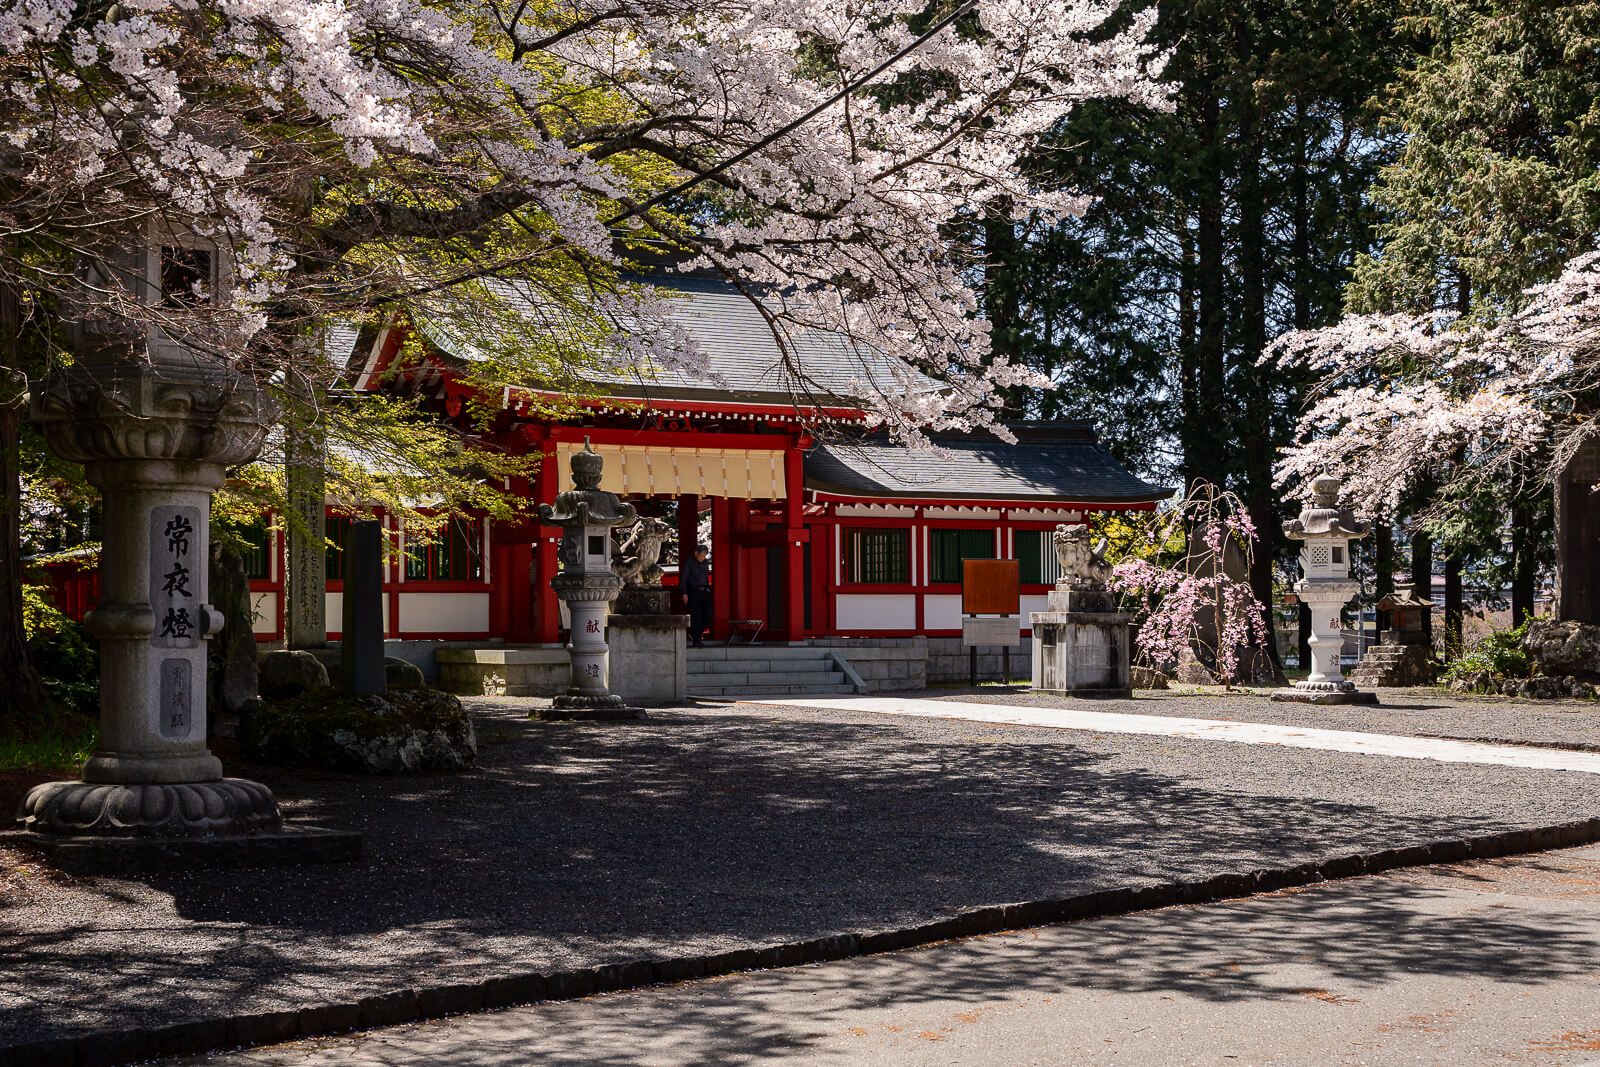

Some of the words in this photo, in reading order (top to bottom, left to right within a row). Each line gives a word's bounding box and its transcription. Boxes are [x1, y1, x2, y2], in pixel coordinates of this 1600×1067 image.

[159, 514, 194, 639] 常夜燈
[585, 619, 600, 679] 献燈
